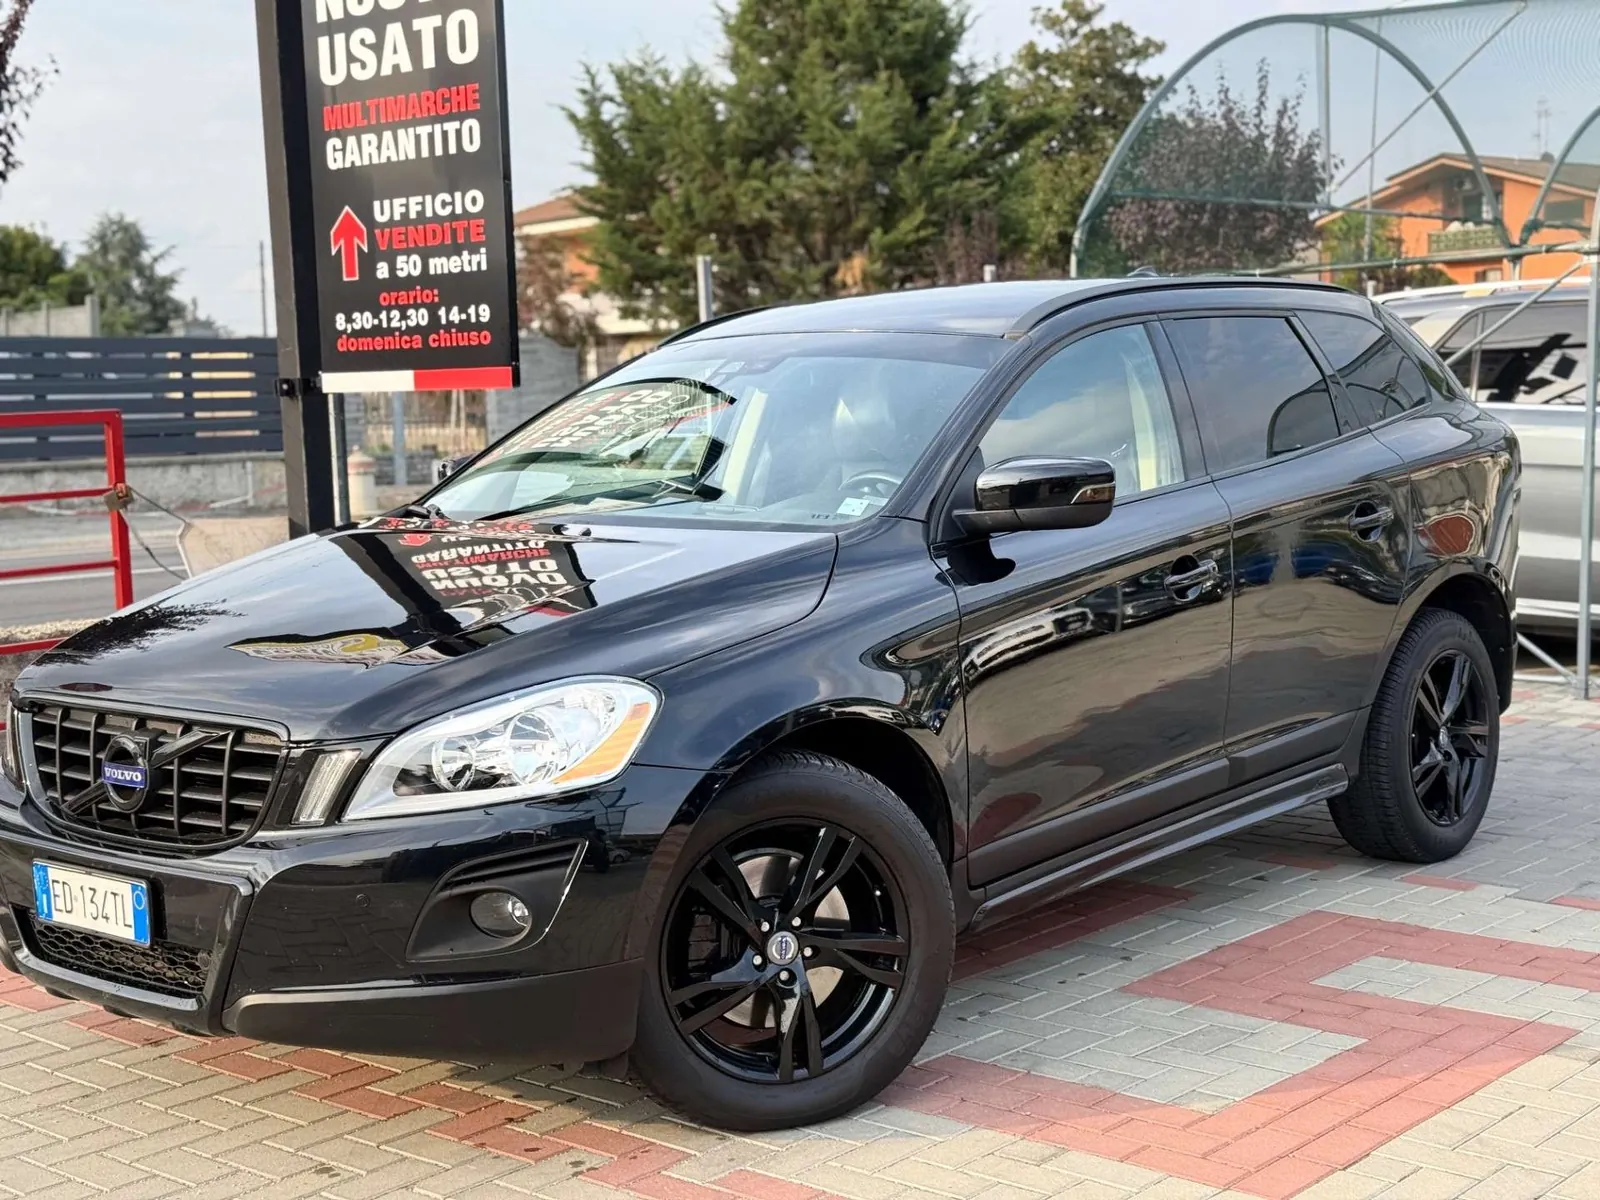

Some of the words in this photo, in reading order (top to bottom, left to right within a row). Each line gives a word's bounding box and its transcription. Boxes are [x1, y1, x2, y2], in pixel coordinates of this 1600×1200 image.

[317, 9, 480, 86] USATO
[323, 83, 481, 132] MULTIMARCHE
[326, 118, 481, 171] GARANTITO
[373, 189, 485, 223] UFFICIO
[374, 218, 486, 251] VENDITE
[376, 261, 390, 280] a
[396, 254, 422, 278] 50
[428, 247, 488, 275] metri
[379, 285, 440, 307] orario:
[335, 307, 429, 334] 8,30-12,30
[438, 303, 491, 326] 14-19
[337, 331, 423, 352] domenica
[428, 328, 492, 348] chiuso
[104, 766, 142, 782] VOLVO
